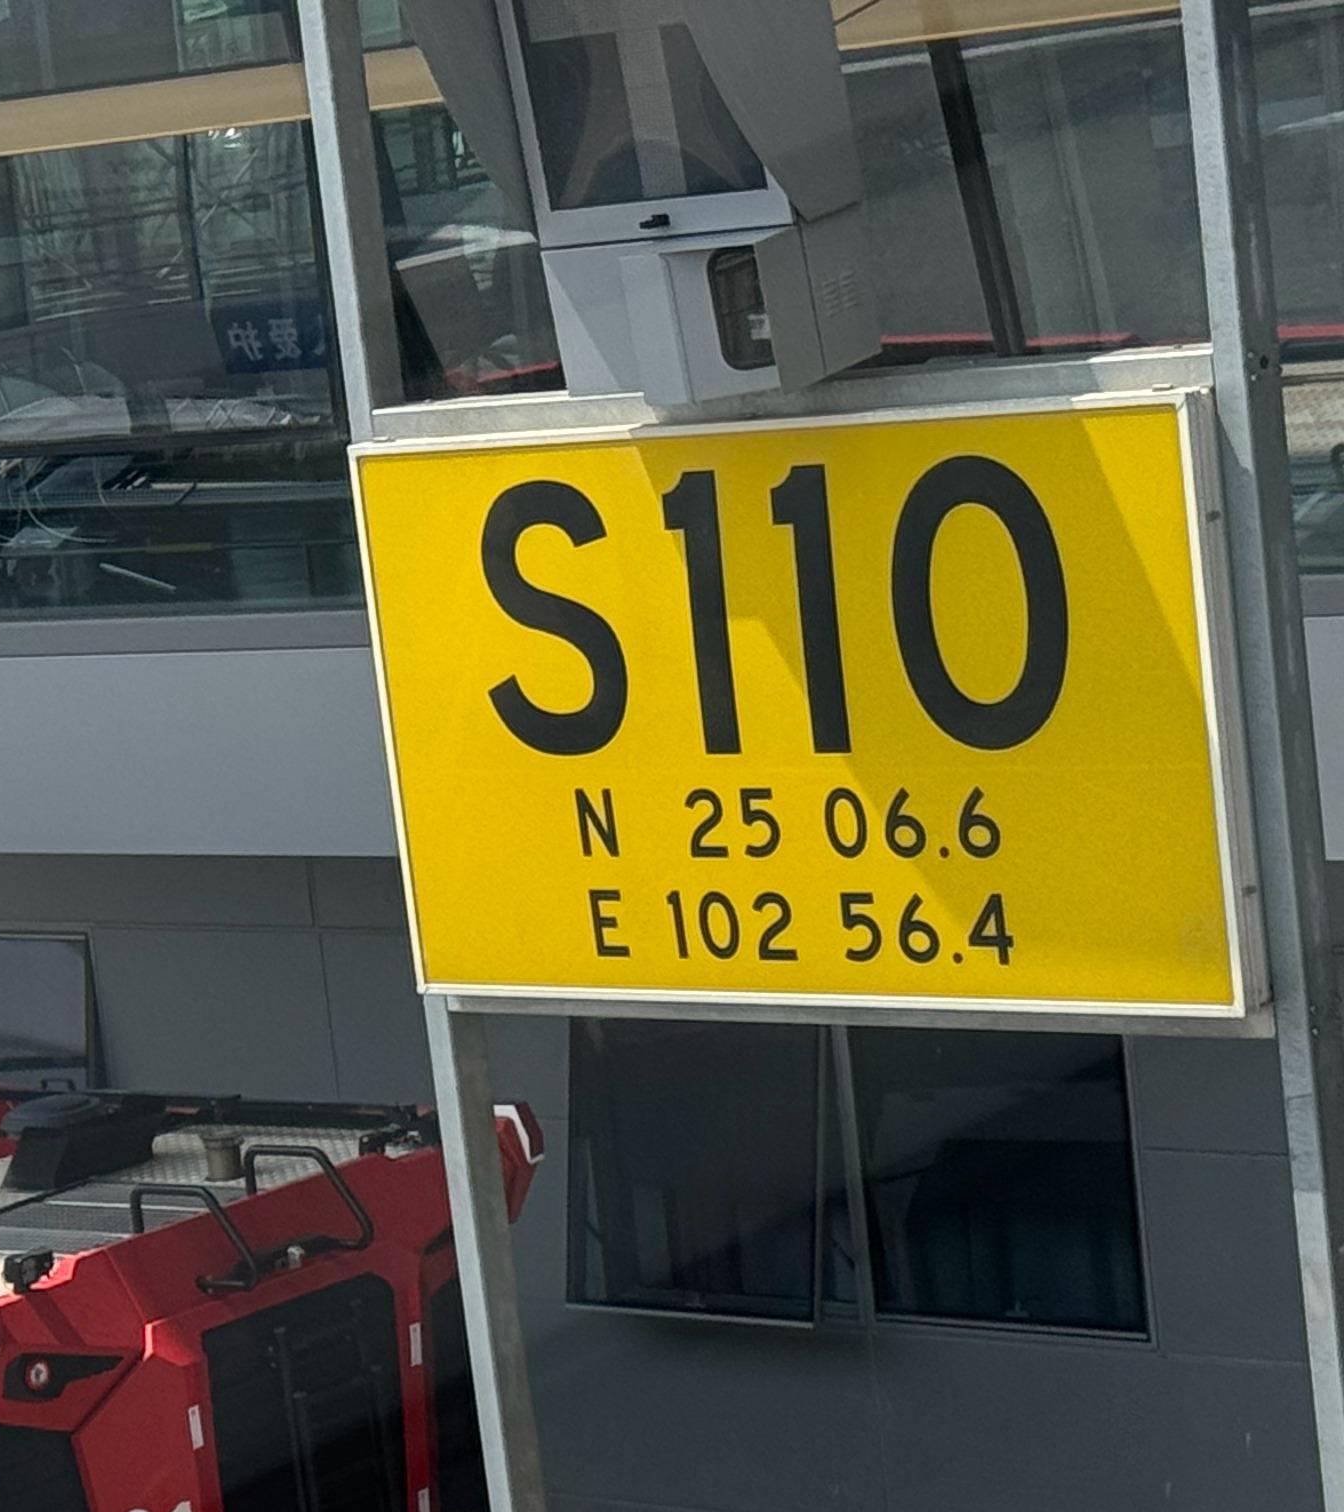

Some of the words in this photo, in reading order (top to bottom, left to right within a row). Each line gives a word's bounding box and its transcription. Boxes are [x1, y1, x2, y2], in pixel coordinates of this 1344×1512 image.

[479, 454, 1070, 756] S110
[576, 787, 621, 858] N
[685, 787, 782, 859] 25
[824, 785, 1004, 860] 06.6
[588, 888, 631, 958] E
[666, 888, 799, 961] 102
[839, 890, 1015, 966] 56.4
